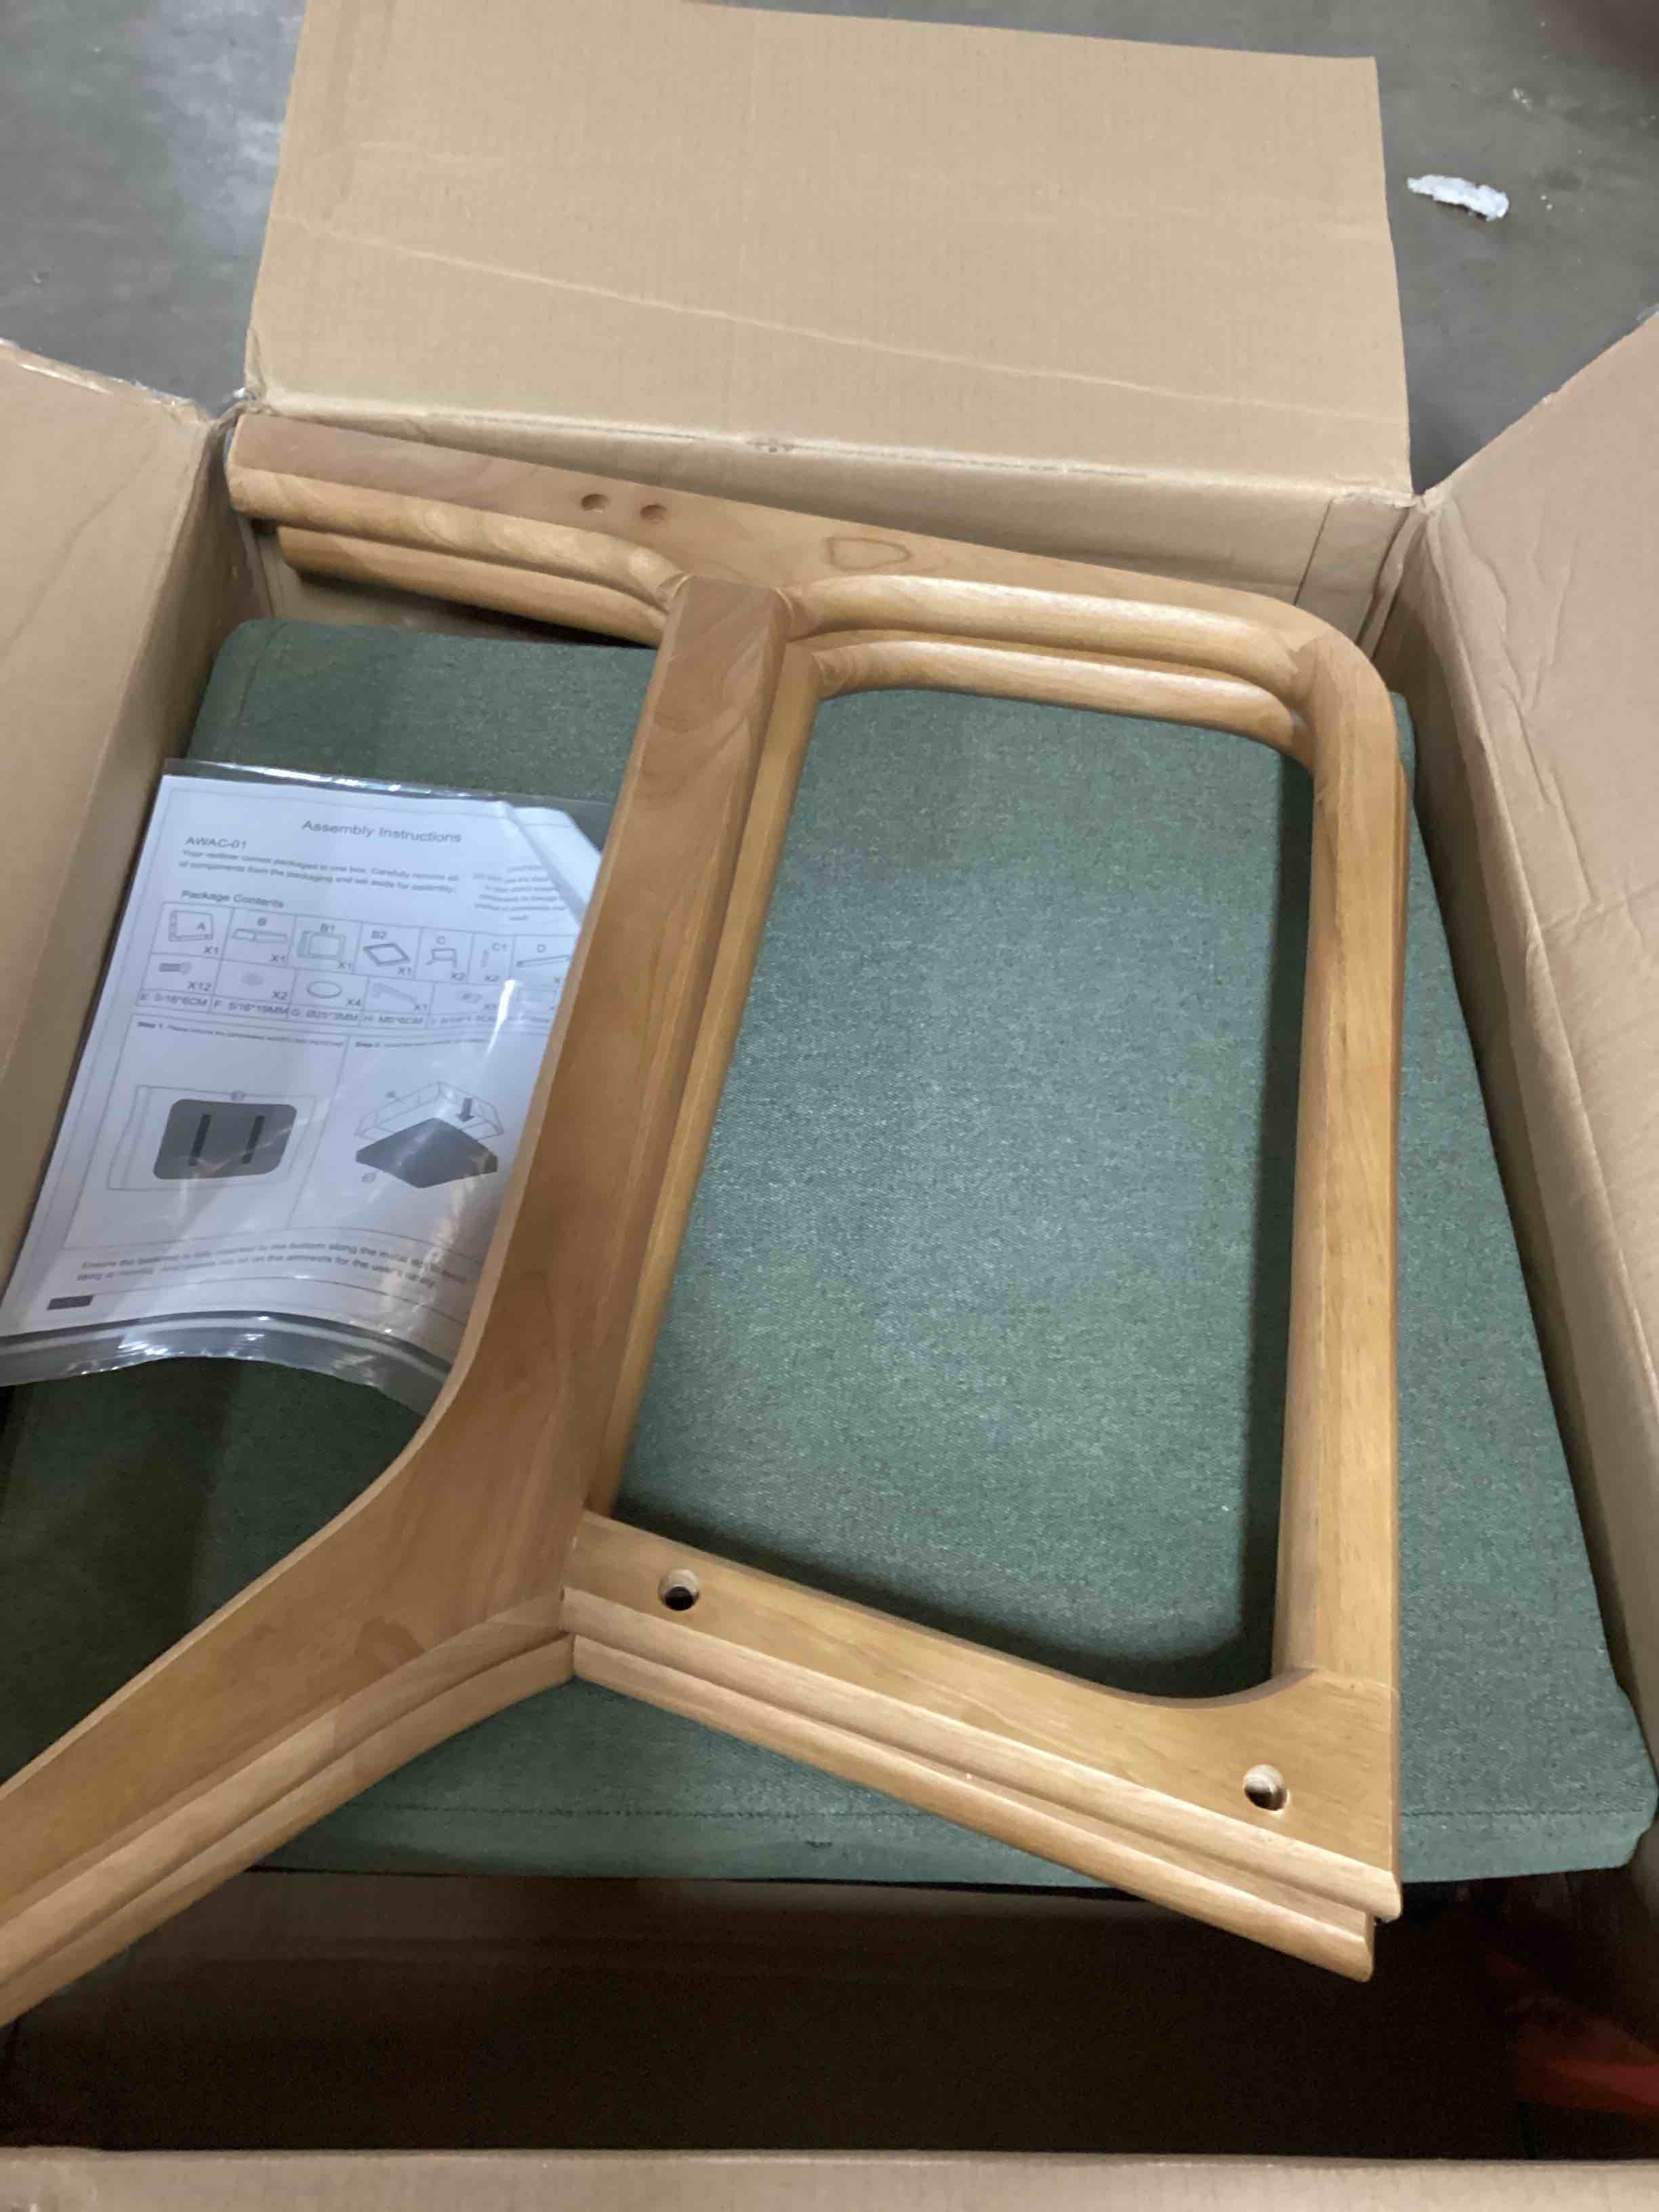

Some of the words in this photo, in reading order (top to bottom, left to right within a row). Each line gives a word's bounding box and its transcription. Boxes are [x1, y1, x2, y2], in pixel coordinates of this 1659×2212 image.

[301, 820, 375, 838] Assembly
[378, 826, 462, 842] Instructions
[184, 836, 247, 849] AWAC-01
[181, 889, 231, 902] Package
[233, 894, 285, 909] Contents
[196, 922, 207, 931] A
[435, 935, 446, 946] C
[186, 981, 213, 991] X12
[272, 991, 288, 1001] X2
[346, 998, 362, 1007] X4
